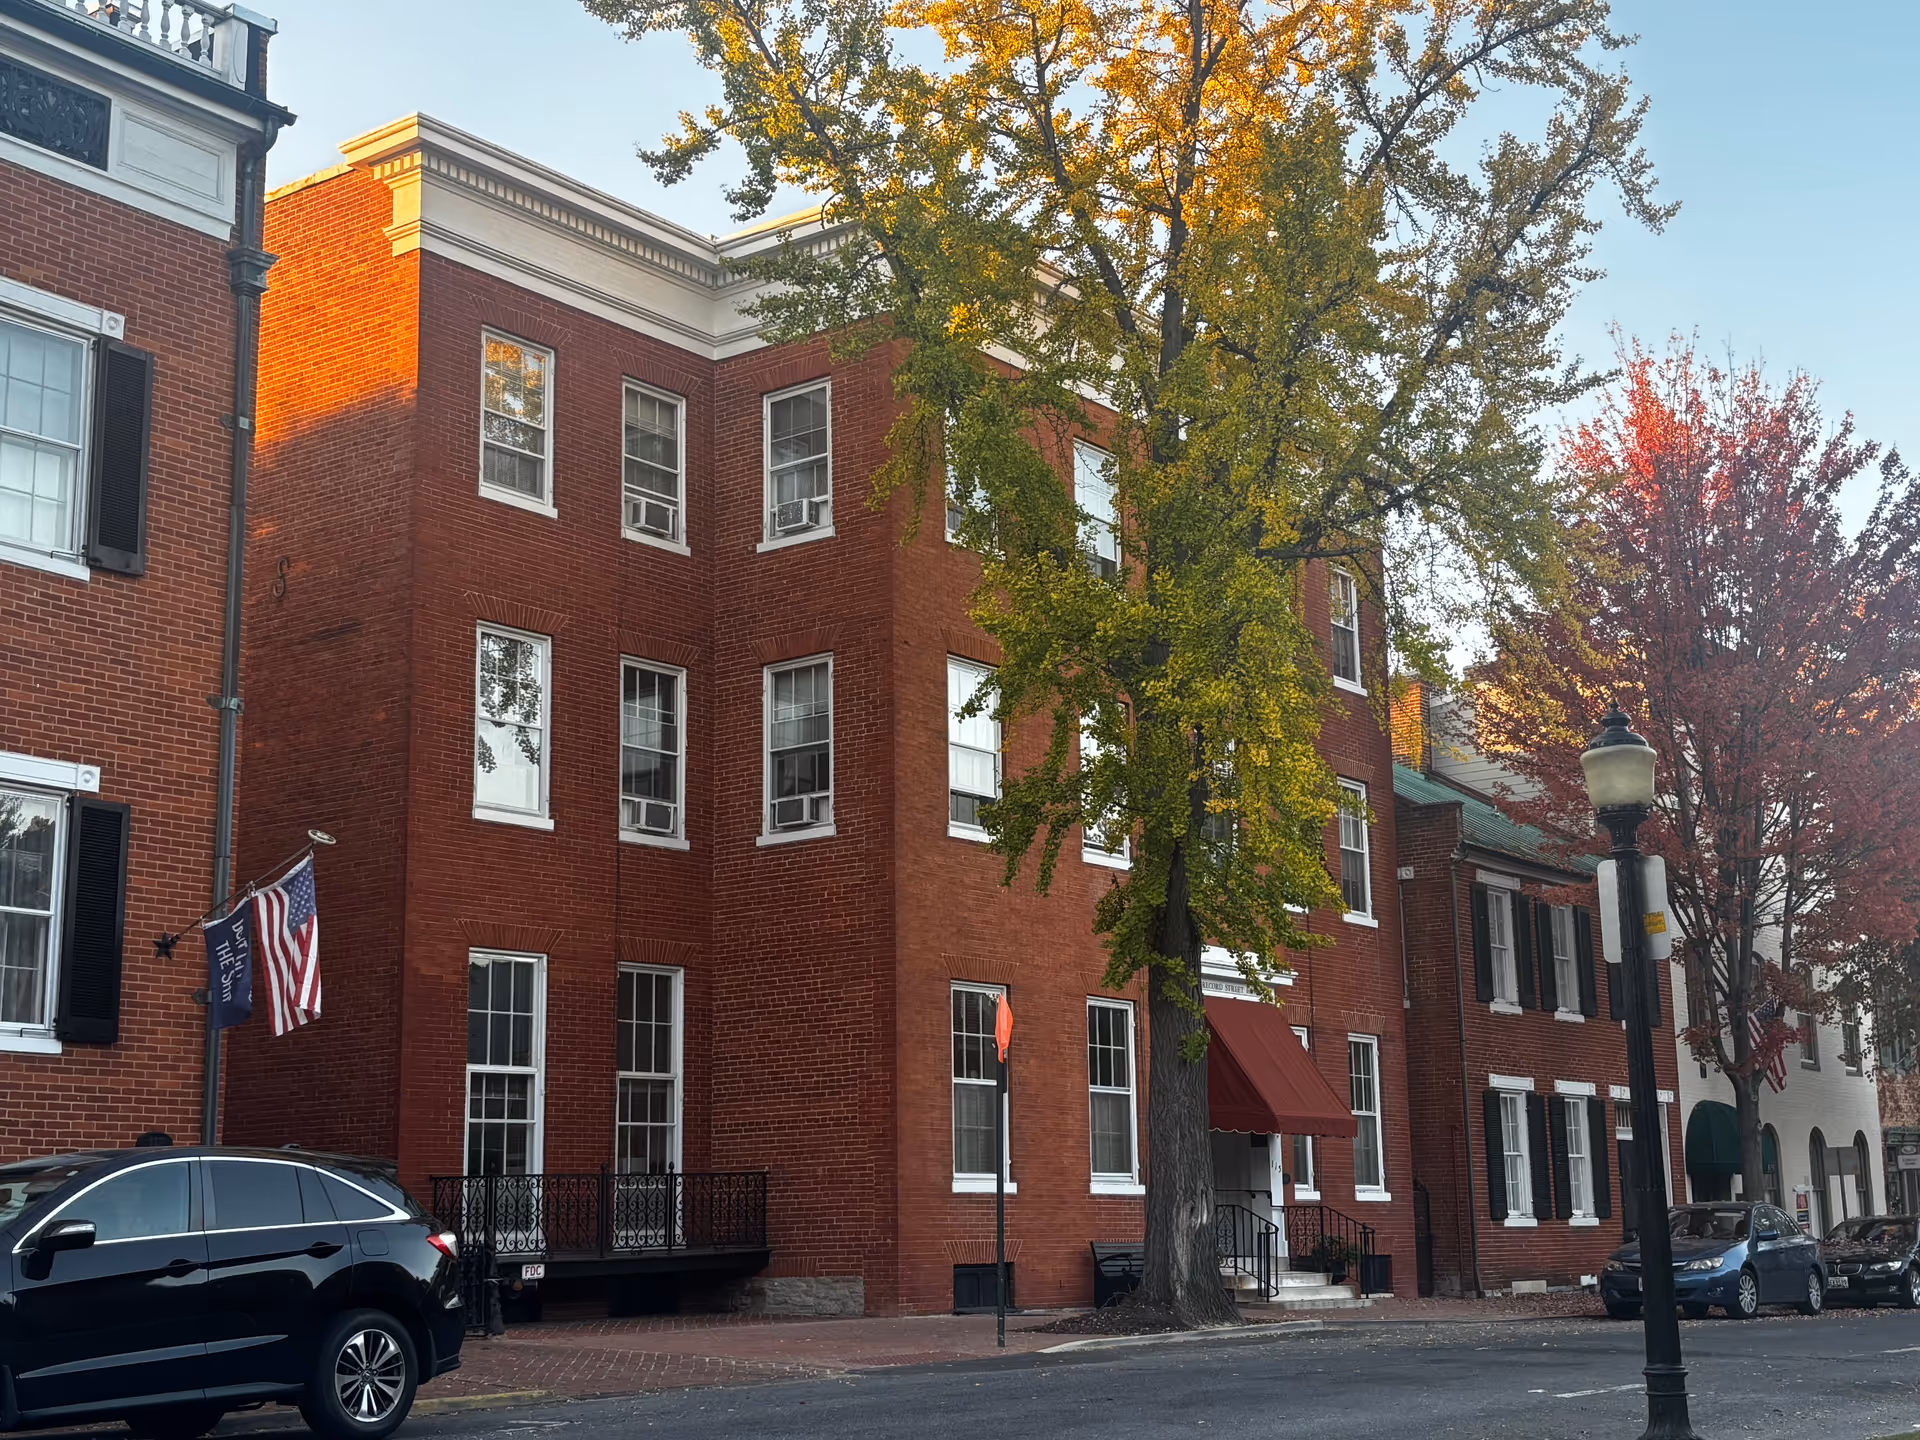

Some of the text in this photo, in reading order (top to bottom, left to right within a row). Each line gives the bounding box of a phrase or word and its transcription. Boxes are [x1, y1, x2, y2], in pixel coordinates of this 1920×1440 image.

[215, 940, 235, 970] THE
[1202, 981, 1224, 991] RECORD
[1224, 983, 1244, 994] STREET
[525, 1265, 541, 1277] FDC
